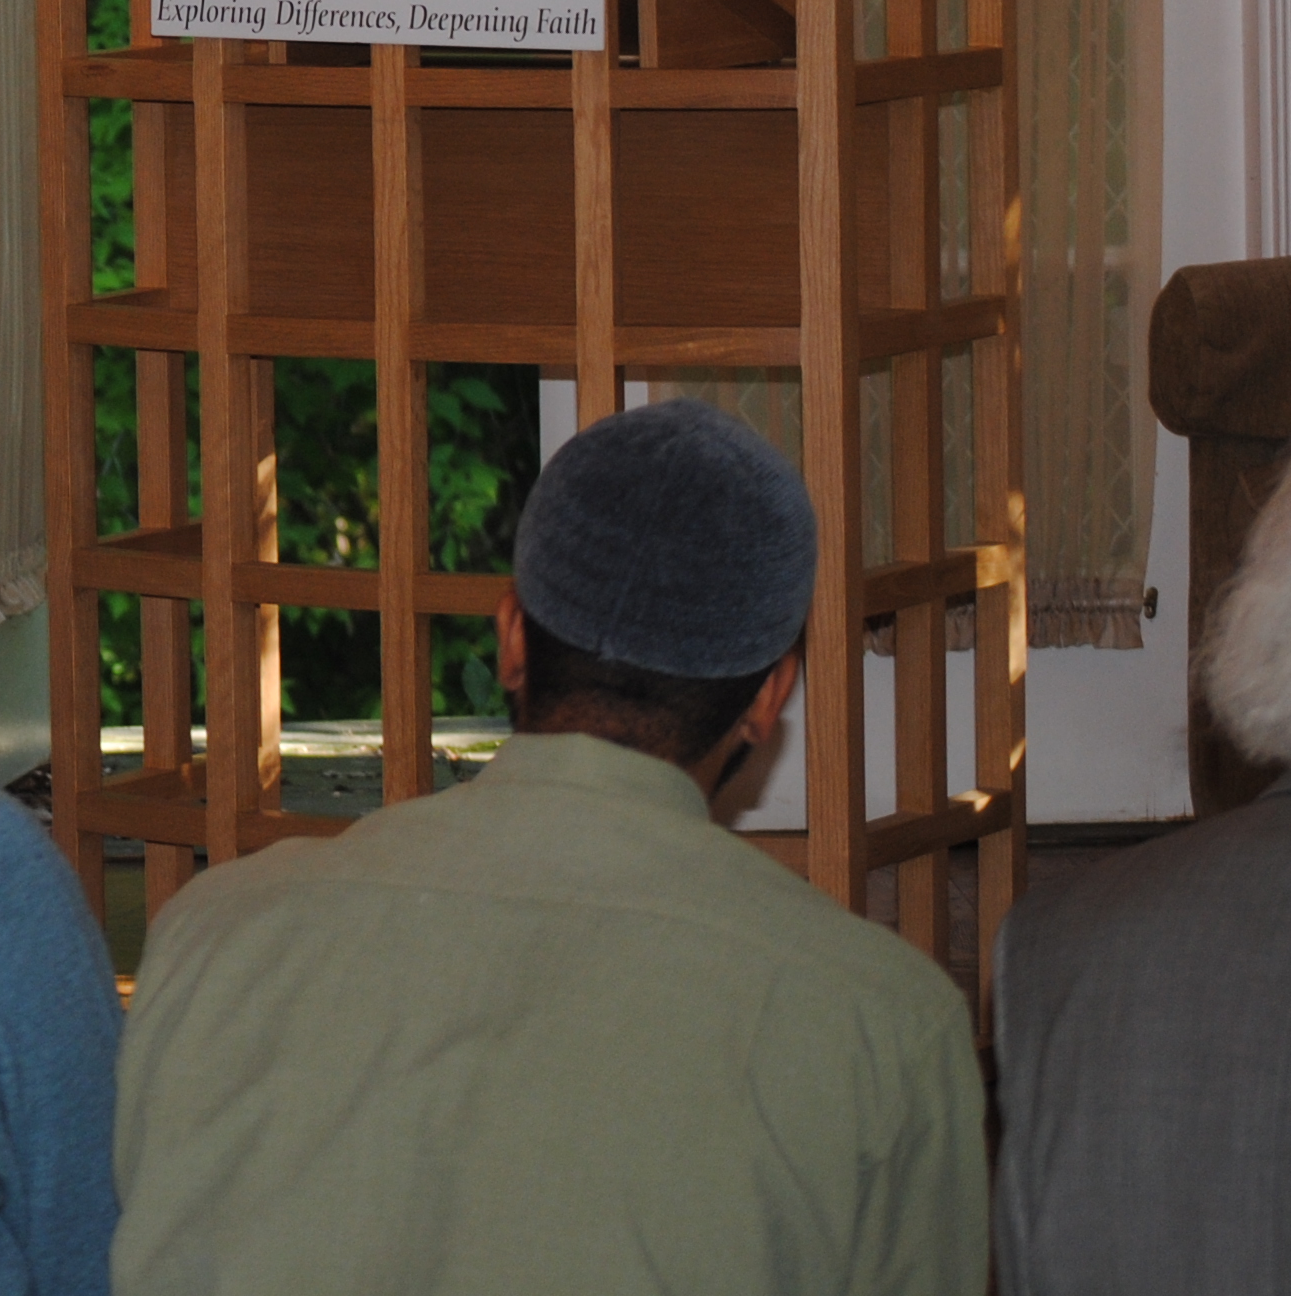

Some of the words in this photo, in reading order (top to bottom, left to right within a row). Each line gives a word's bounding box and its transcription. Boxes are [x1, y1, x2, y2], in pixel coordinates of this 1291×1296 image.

[276, 0, 401, 35] Differences,
[408, 4, 529, 42] Deepening
[536, 7, 597, 35] Faith
